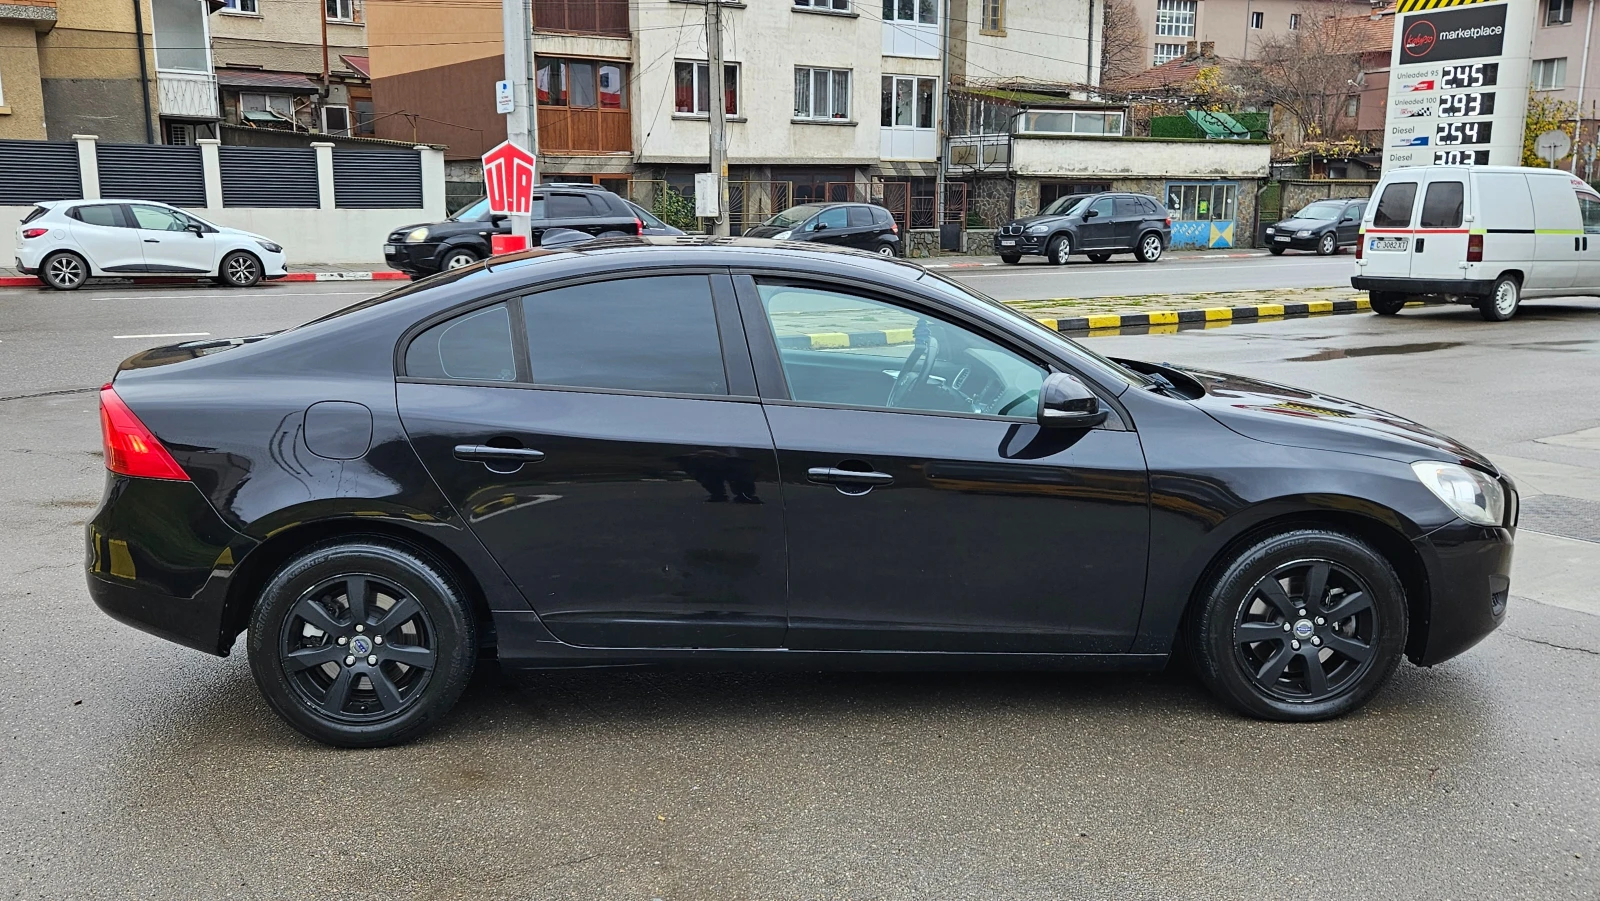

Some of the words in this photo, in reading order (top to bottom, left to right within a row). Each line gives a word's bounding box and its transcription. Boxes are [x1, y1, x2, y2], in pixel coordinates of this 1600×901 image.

[1440, 25, 1502, 41] marketplace
[1397, 71, 1428, 80] Unleaded
[1441, 64, 1483, 89] 2.45
[1394, 98, 1425, 106] Unleaded
[1438, 93, 1482, 118] 2.93
[1392, 126, 1415, 134] Diesel
[1435, 122, 1478, 145] 2.54
[1389, 154, 1413, 162] Diesel
